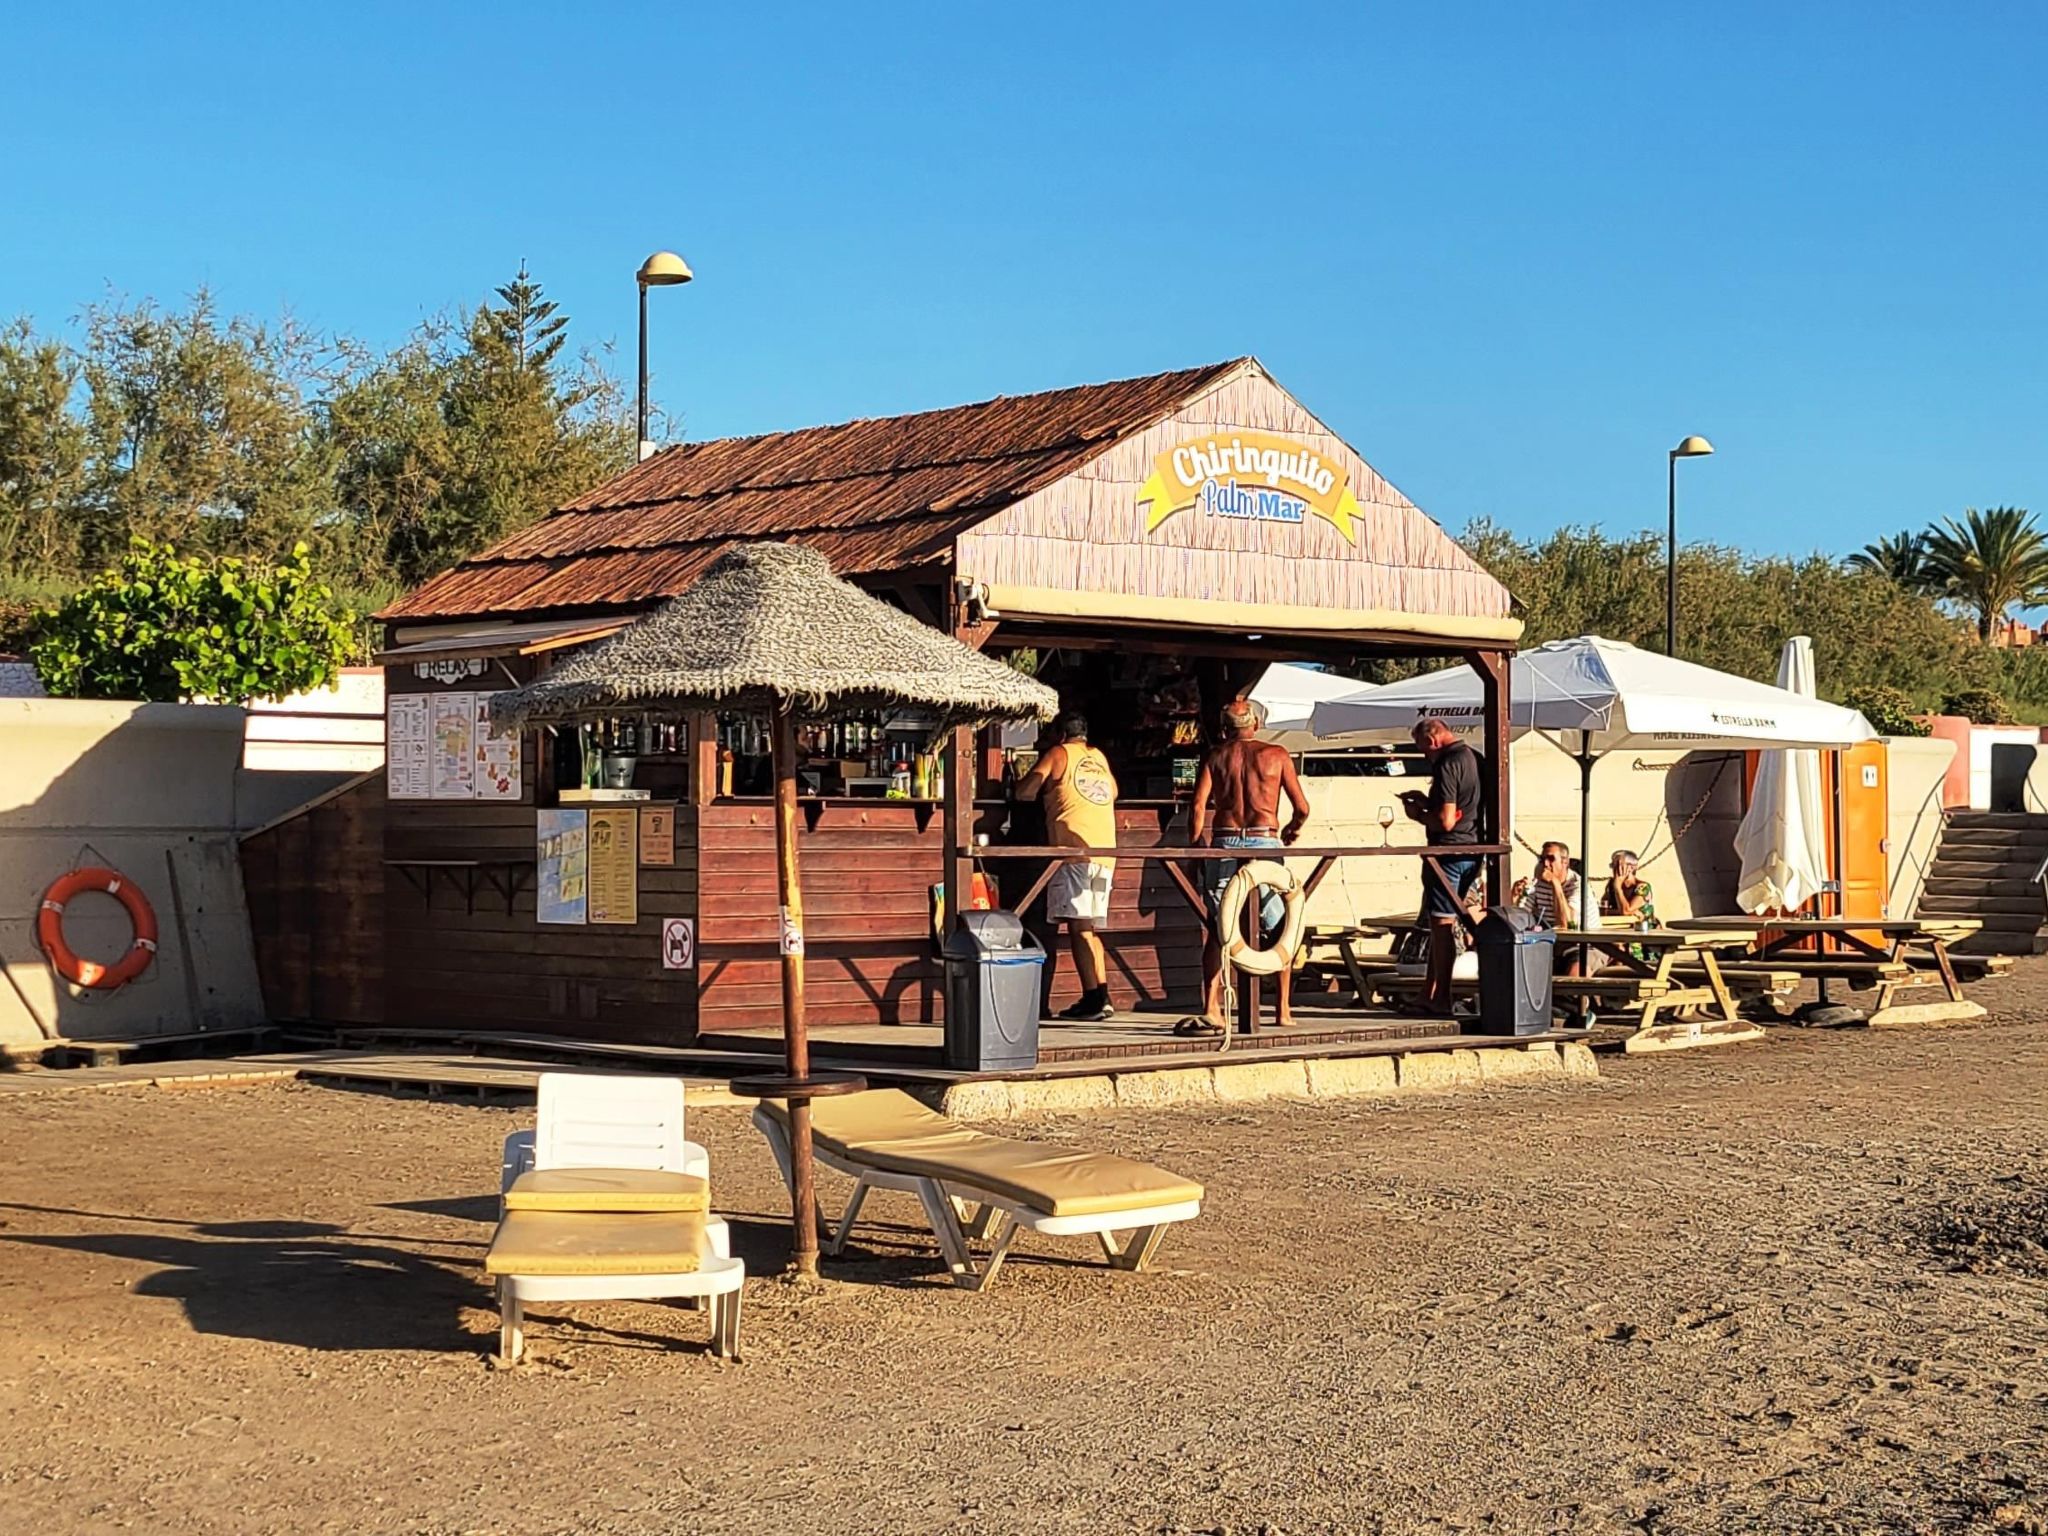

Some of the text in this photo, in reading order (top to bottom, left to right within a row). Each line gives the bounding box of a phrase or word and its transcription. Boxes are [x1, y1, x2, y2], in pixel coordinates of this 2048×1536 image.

[1172, 438, 1336, 495] Chiringuito
[1203, 479, 1303, 520] Palm Mar
[427, 659, 471, 676] RELAX
[1429, 706, 1487, 717] ESTRELLA DA
